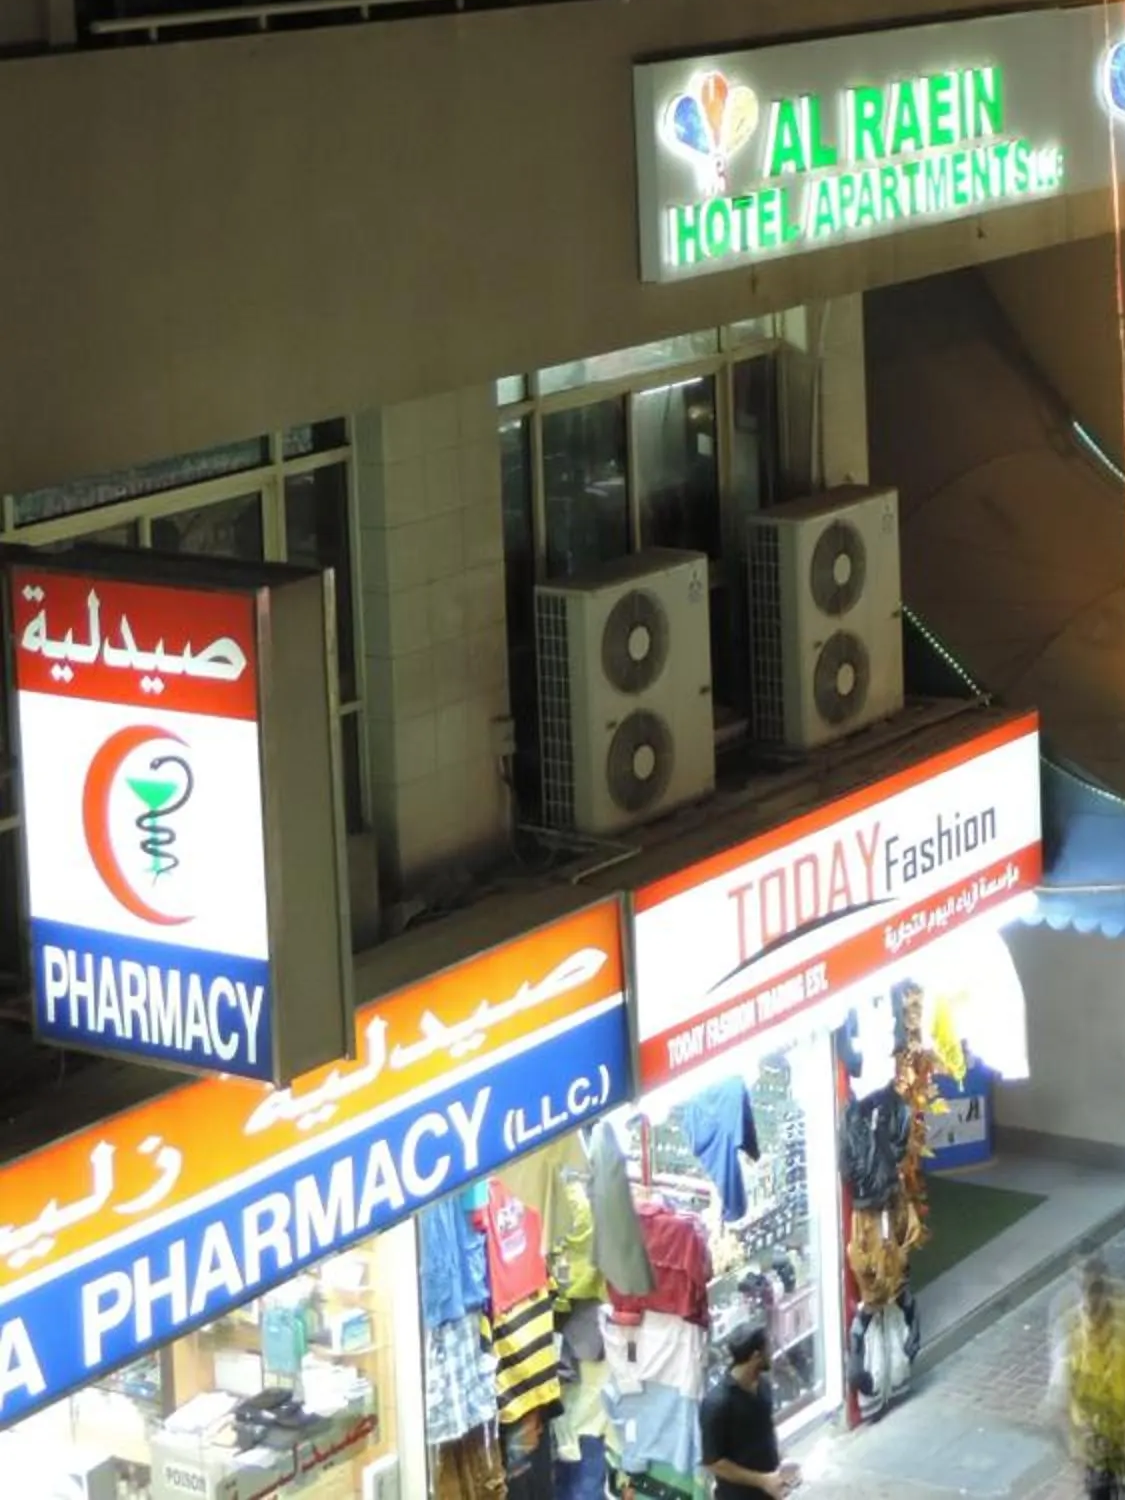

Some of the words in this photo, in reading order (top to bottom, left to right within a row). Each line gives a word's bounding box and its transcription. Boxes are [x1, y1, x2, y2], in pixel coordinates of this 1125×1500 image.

[763, 94, 837, 177] AL
[845, 66, 1002, 166] RAEIN
[667, 186, 800, 267] HOTEL
[806, 137, 1033, 239] APARTMENTS
[20, 583, 248, 694] صيدلية
[728, 820, 881, 966] TODAY
[883, 805, 997, 892] Fashion
[43, 945, 265, 1064] PHARMACY
[81, 1086, 491, 1368] PHARMACY
